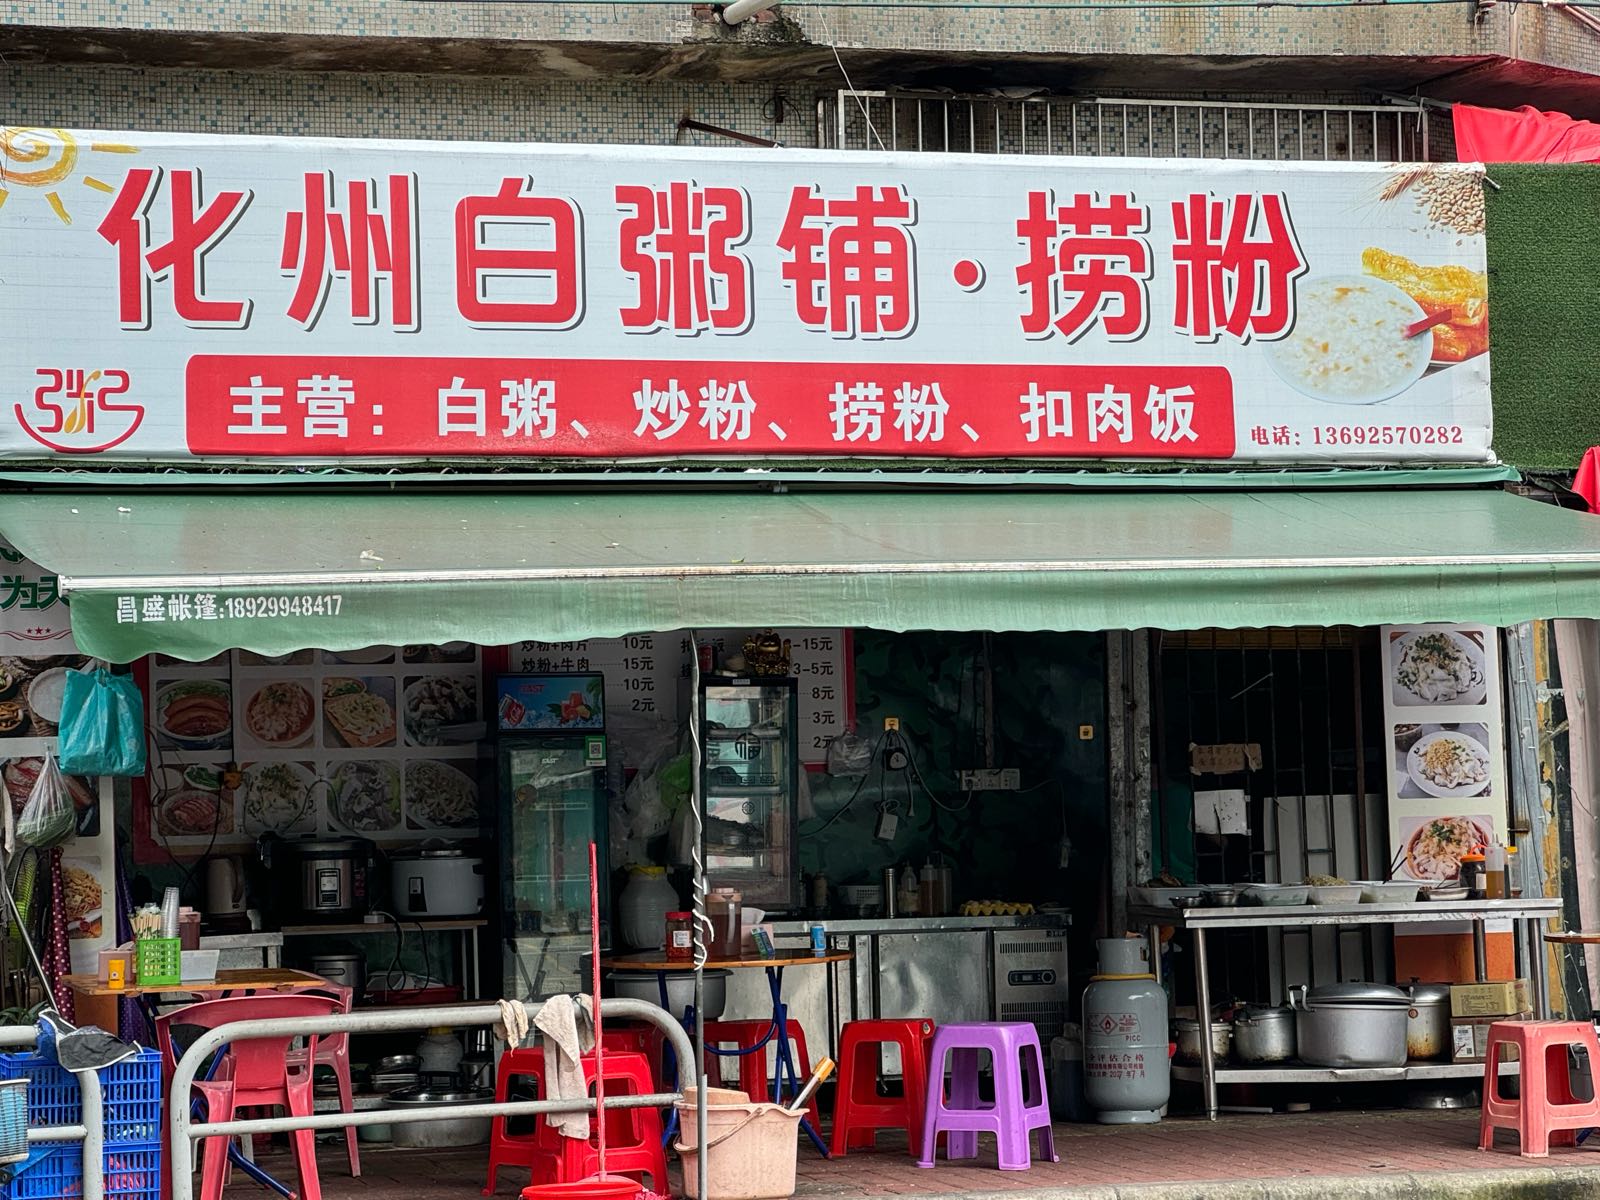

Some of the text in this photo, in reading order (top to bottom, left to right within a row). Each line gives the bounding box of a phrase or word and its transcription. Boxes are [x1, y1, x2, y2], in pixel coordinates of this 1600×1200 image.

[97, 166, 1309, 346] 化州白粥铺·捞粉
[622, 636, 654, 650] 10元
[623, 657, 655, 671] 15元
[623, 678, 655, 692] 10元
[812, 686, 835, 700] 8元
[632, 698, 655, 712] 2元
[812, 711, 836, 725] 3元
